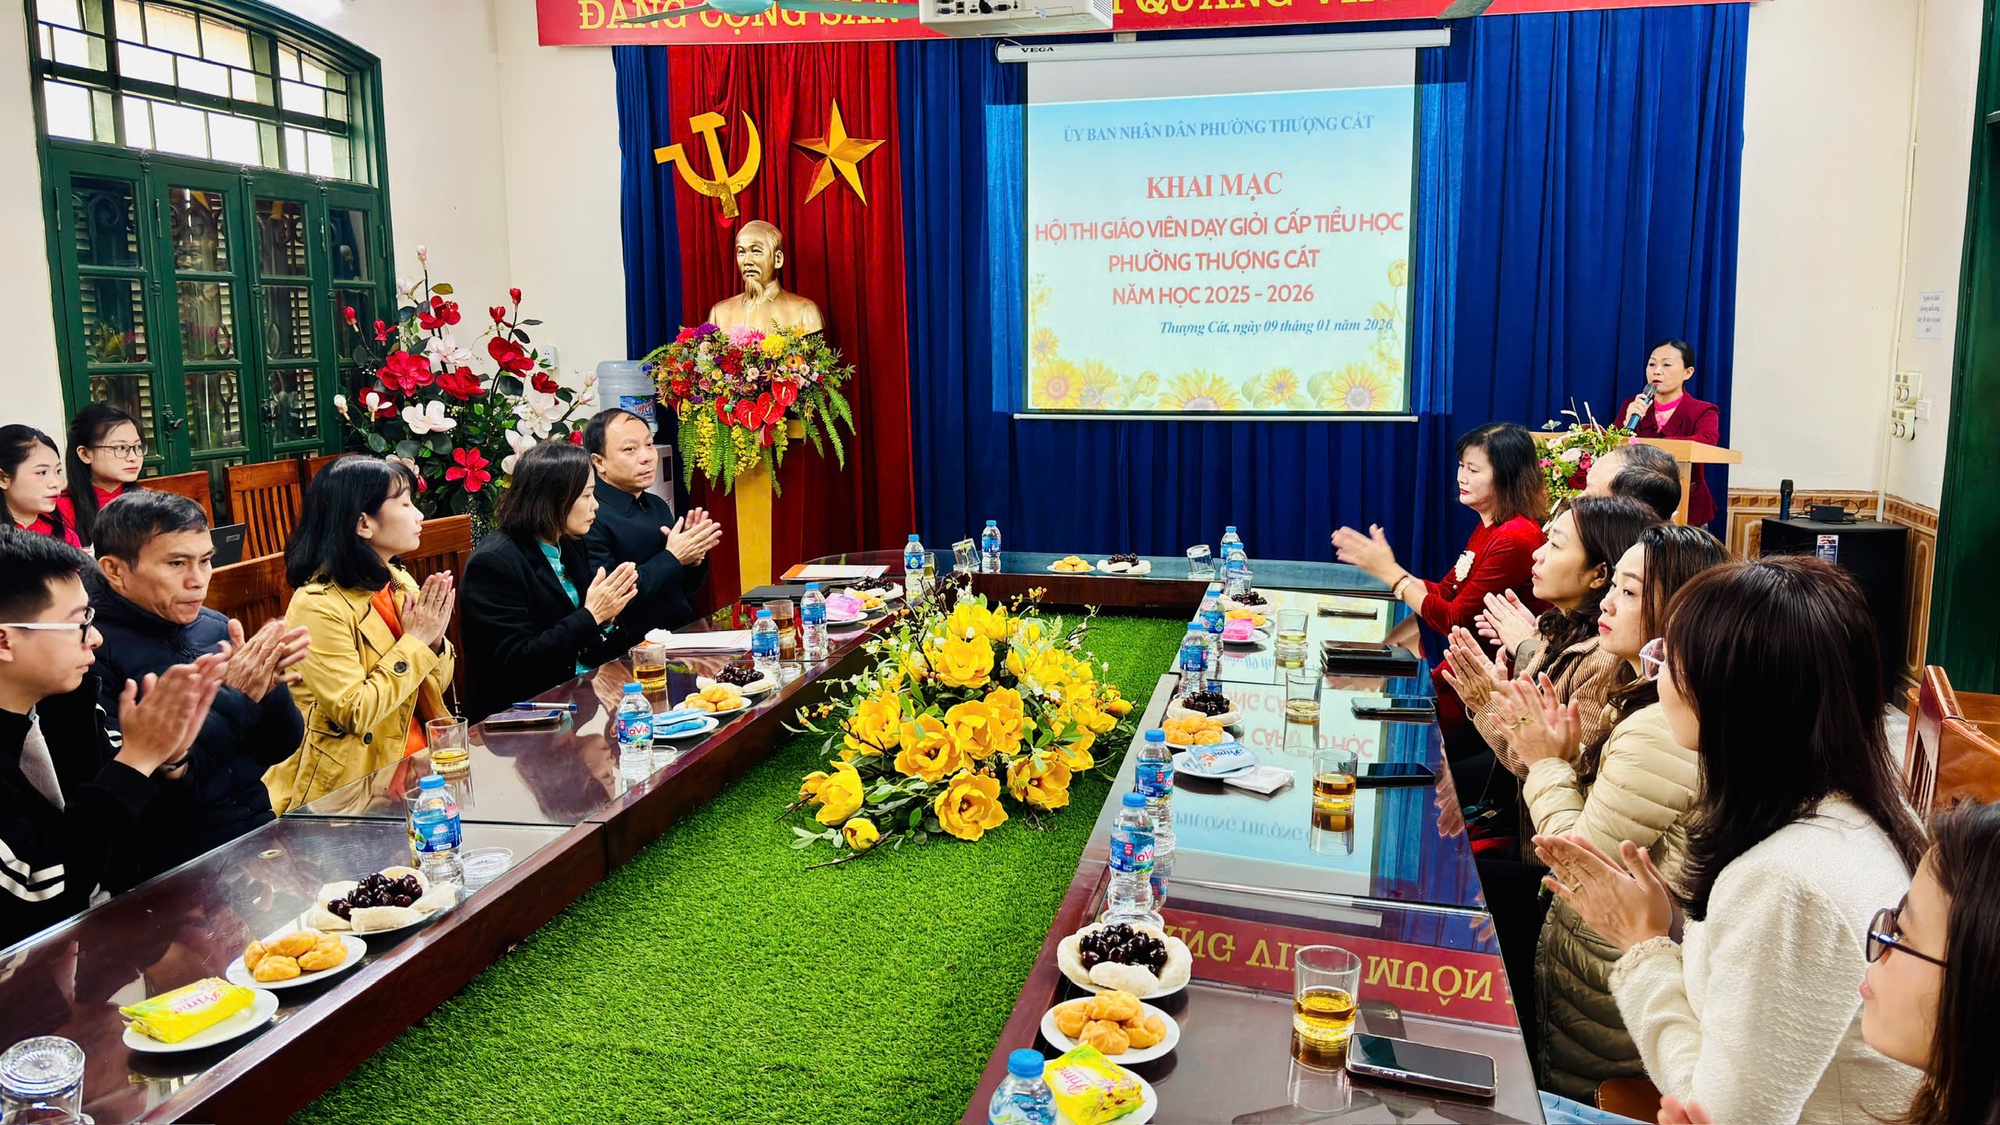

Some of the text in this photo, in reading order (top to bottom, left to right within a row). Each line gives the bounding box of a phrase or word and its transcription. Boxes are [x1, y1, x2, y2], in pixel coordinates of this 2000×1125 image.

[1064, 111, 1375, 143] ỦY BAN NHÂN DÂN PHƯỜNG THƯỢNG CÁT
[1146, 171, 1283, 202] KHAI MẠC
[1035, 205, 1405, 245] HỘI THI GIÁO VIÊN DẠY GIỎI CẤP TIỂU HỌC
[1109, 244, 1321, 274] PHƯỜNG THƯỢNG CÁT
[1113, 283, 1155, 305] NĂM
[1159, 286, 1201, 308] HỌC
[1204, 285, 1250, 304] 2025
[1267, 284, 1314, 303] 2026
[1160, 318, 1393, 336] Thượng Cát, ngày 09 tháng 01 năm 2026
